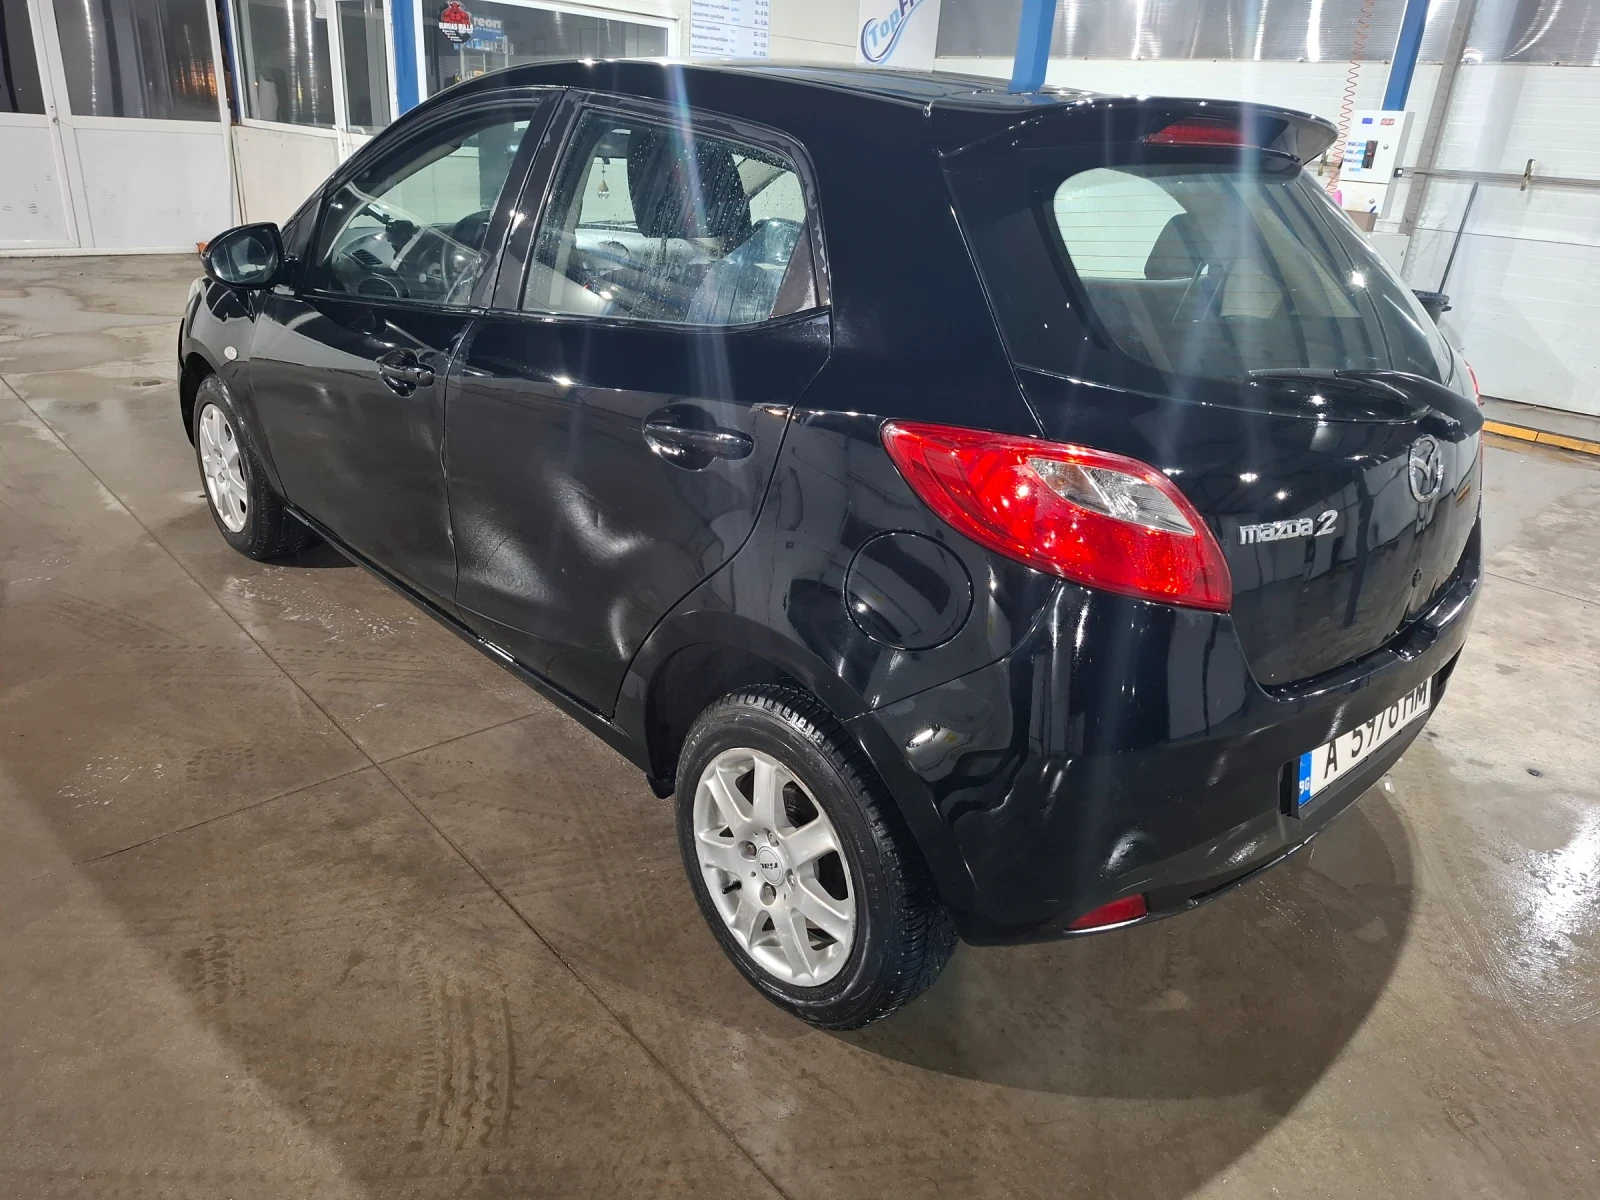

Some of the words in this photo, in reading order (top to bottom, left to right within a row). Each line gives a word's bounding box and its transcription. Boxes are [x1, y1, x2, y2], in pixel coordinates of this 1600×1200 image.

[1238, 518, 1314, 545] mazda
[1313, 509, 1338, 537] 2
[1323, 740, 1338, 780] A
